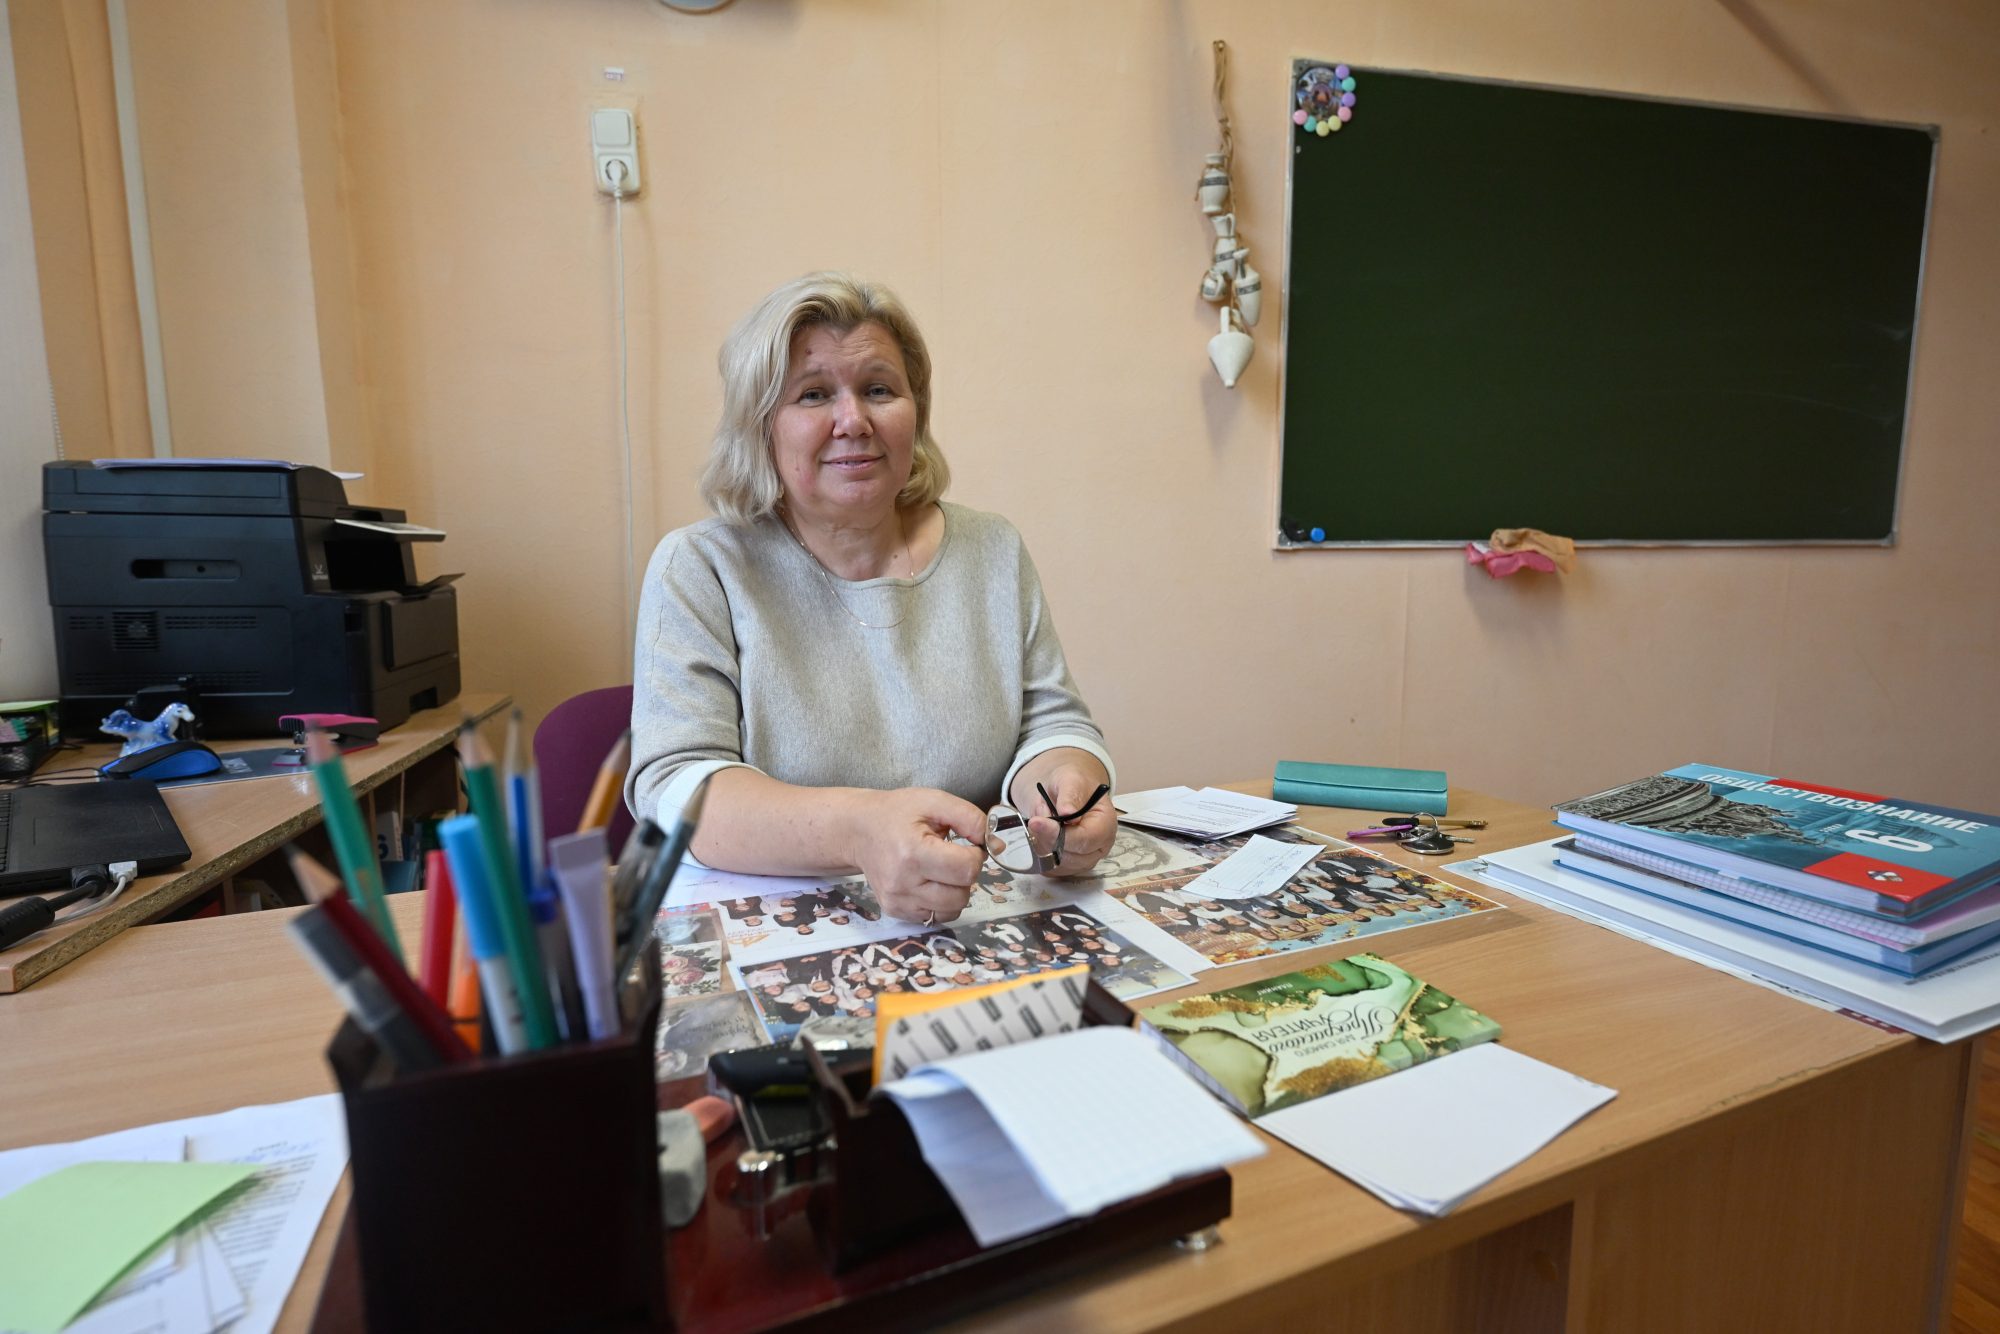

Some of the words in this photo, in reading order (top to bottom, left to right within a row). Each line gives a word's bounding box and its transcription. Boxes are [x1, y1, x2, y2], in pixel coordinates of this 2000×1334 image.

[1697, 773, 1989, 834] ОБЩЕСТВОЗНАНИЕ
[1252, 1014, 1328, 1042] УЧИТЕЛЯ
[1268, 1002, 1398, 1052] Прекрасного
